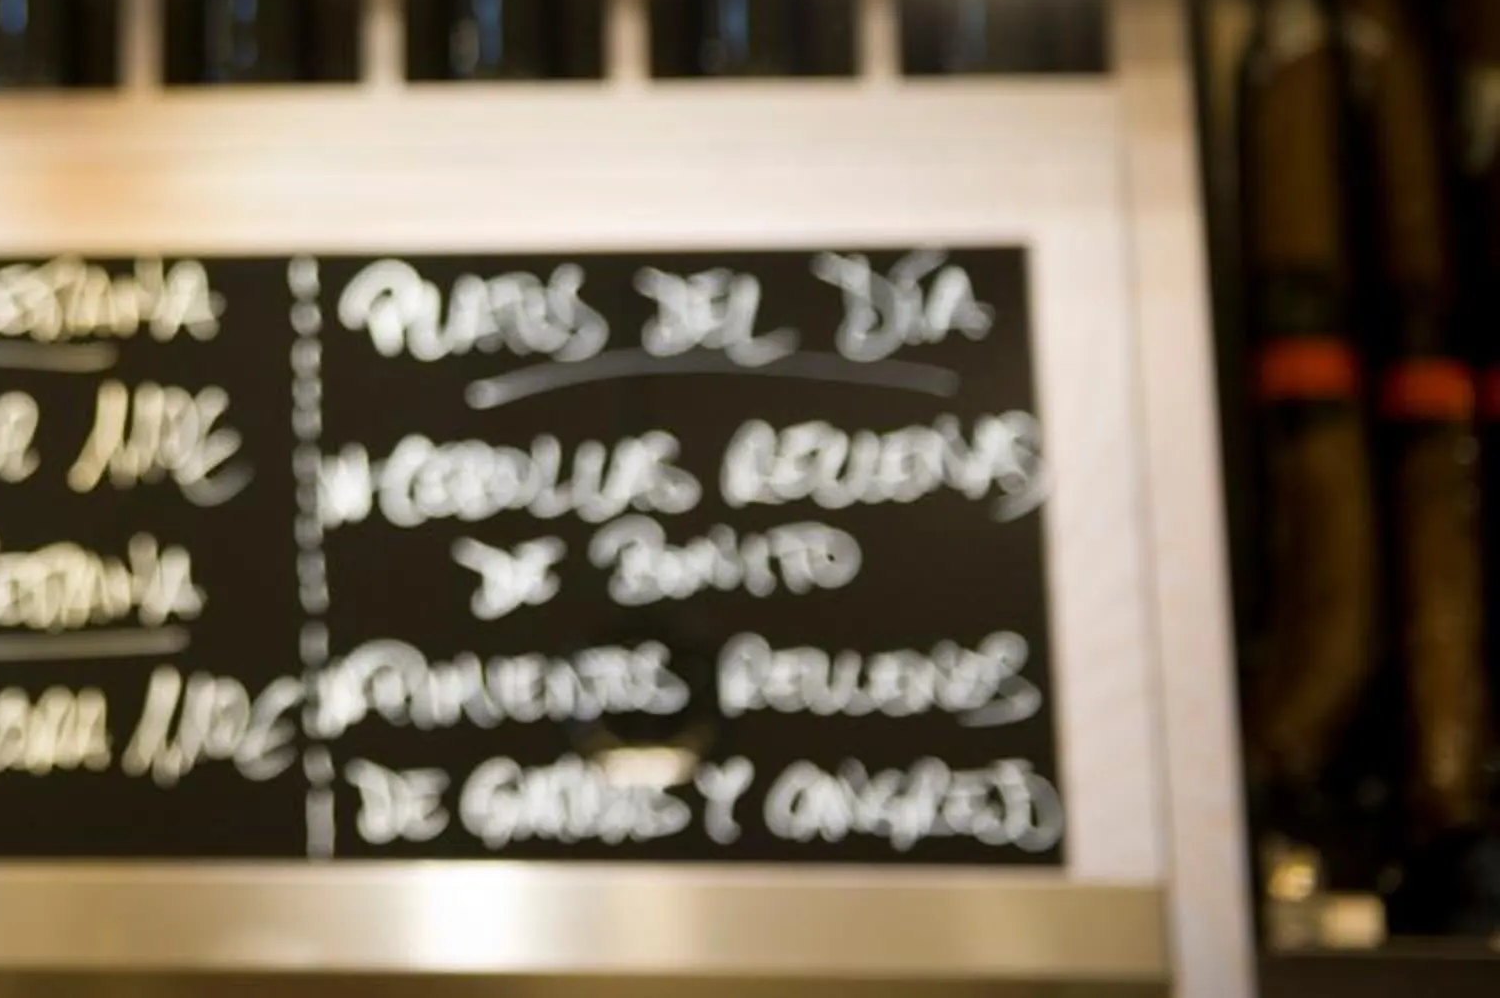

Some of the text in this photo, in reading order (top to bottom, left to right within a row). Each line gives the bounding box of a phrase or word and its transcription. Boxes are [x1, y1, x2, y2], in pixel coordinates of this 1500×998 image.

[337, 257, 610, 362] PLATOS
[632, 265, 801, 368] DEL
[345, 756, 452, 846] DE
[696, 754, 755, 844] Y
